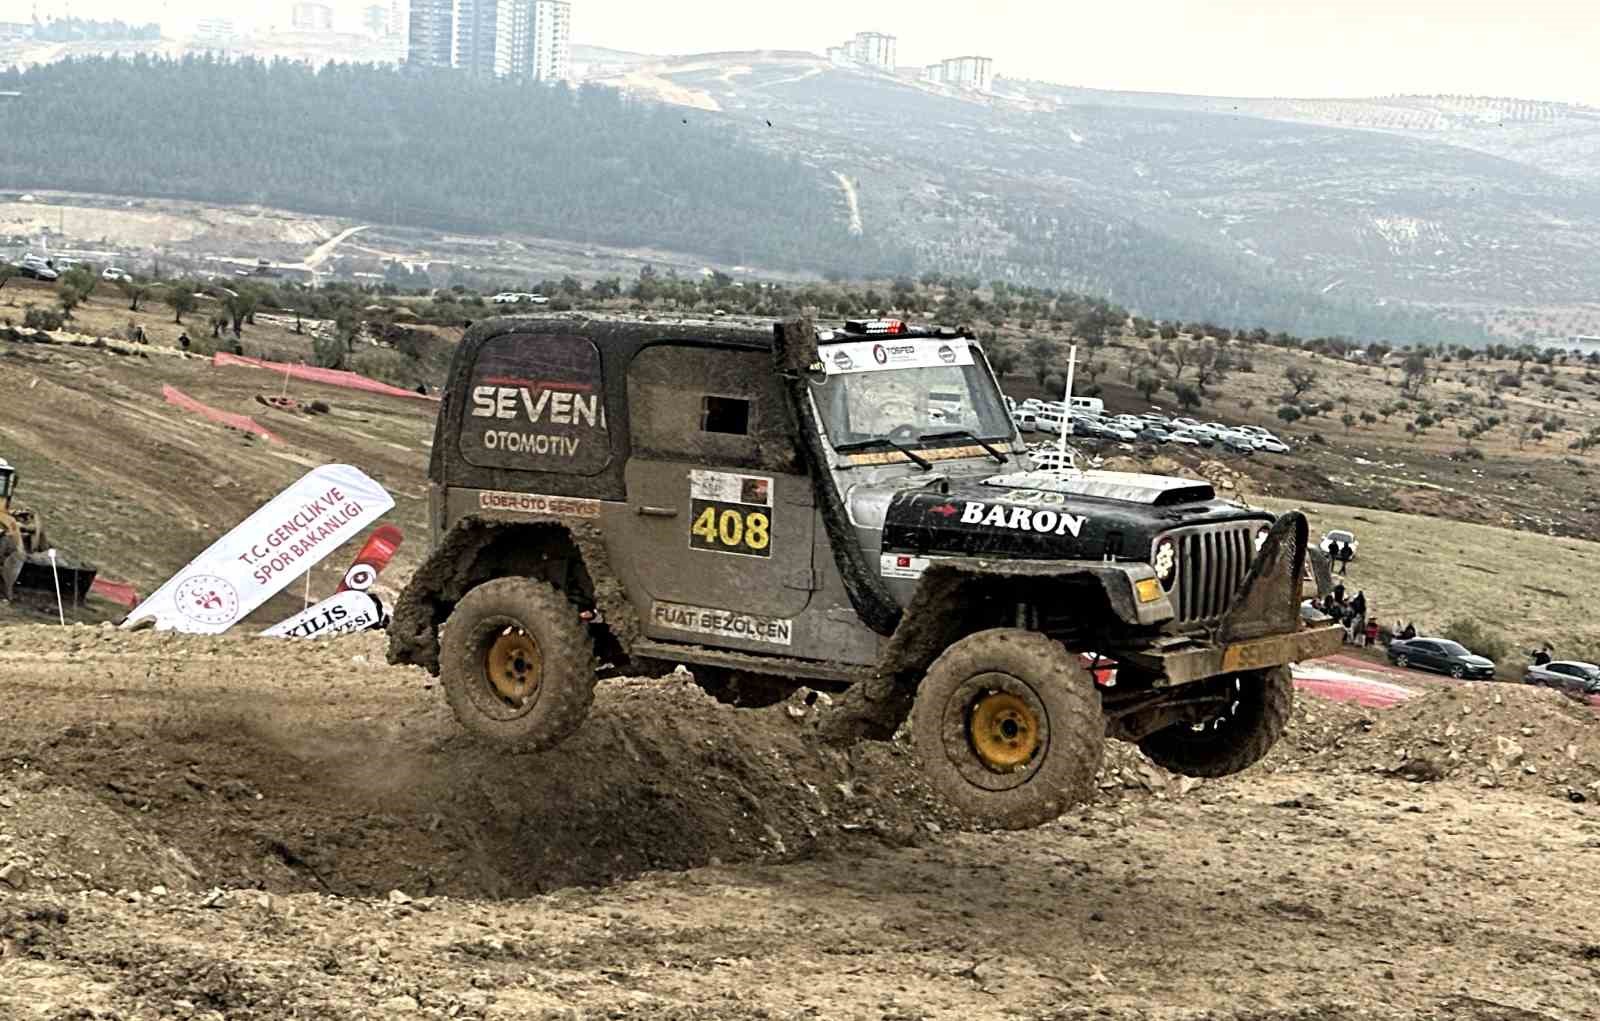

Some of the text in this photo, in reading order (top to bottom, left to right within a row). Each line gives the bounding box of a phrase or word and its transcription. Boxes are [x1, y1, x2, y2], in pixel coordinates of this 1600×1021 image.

[472, 386, 598, 427] SEVEN
[266, 499, 326, 548] GENÇLİK
[320, 487, 345, 506] VE
[692, 506, 769, 549] 408
[960, 501, 1087, 538] BARON
[253, 551, 295, 585] SPOR
[655, 606, 697, 627] FUAT
